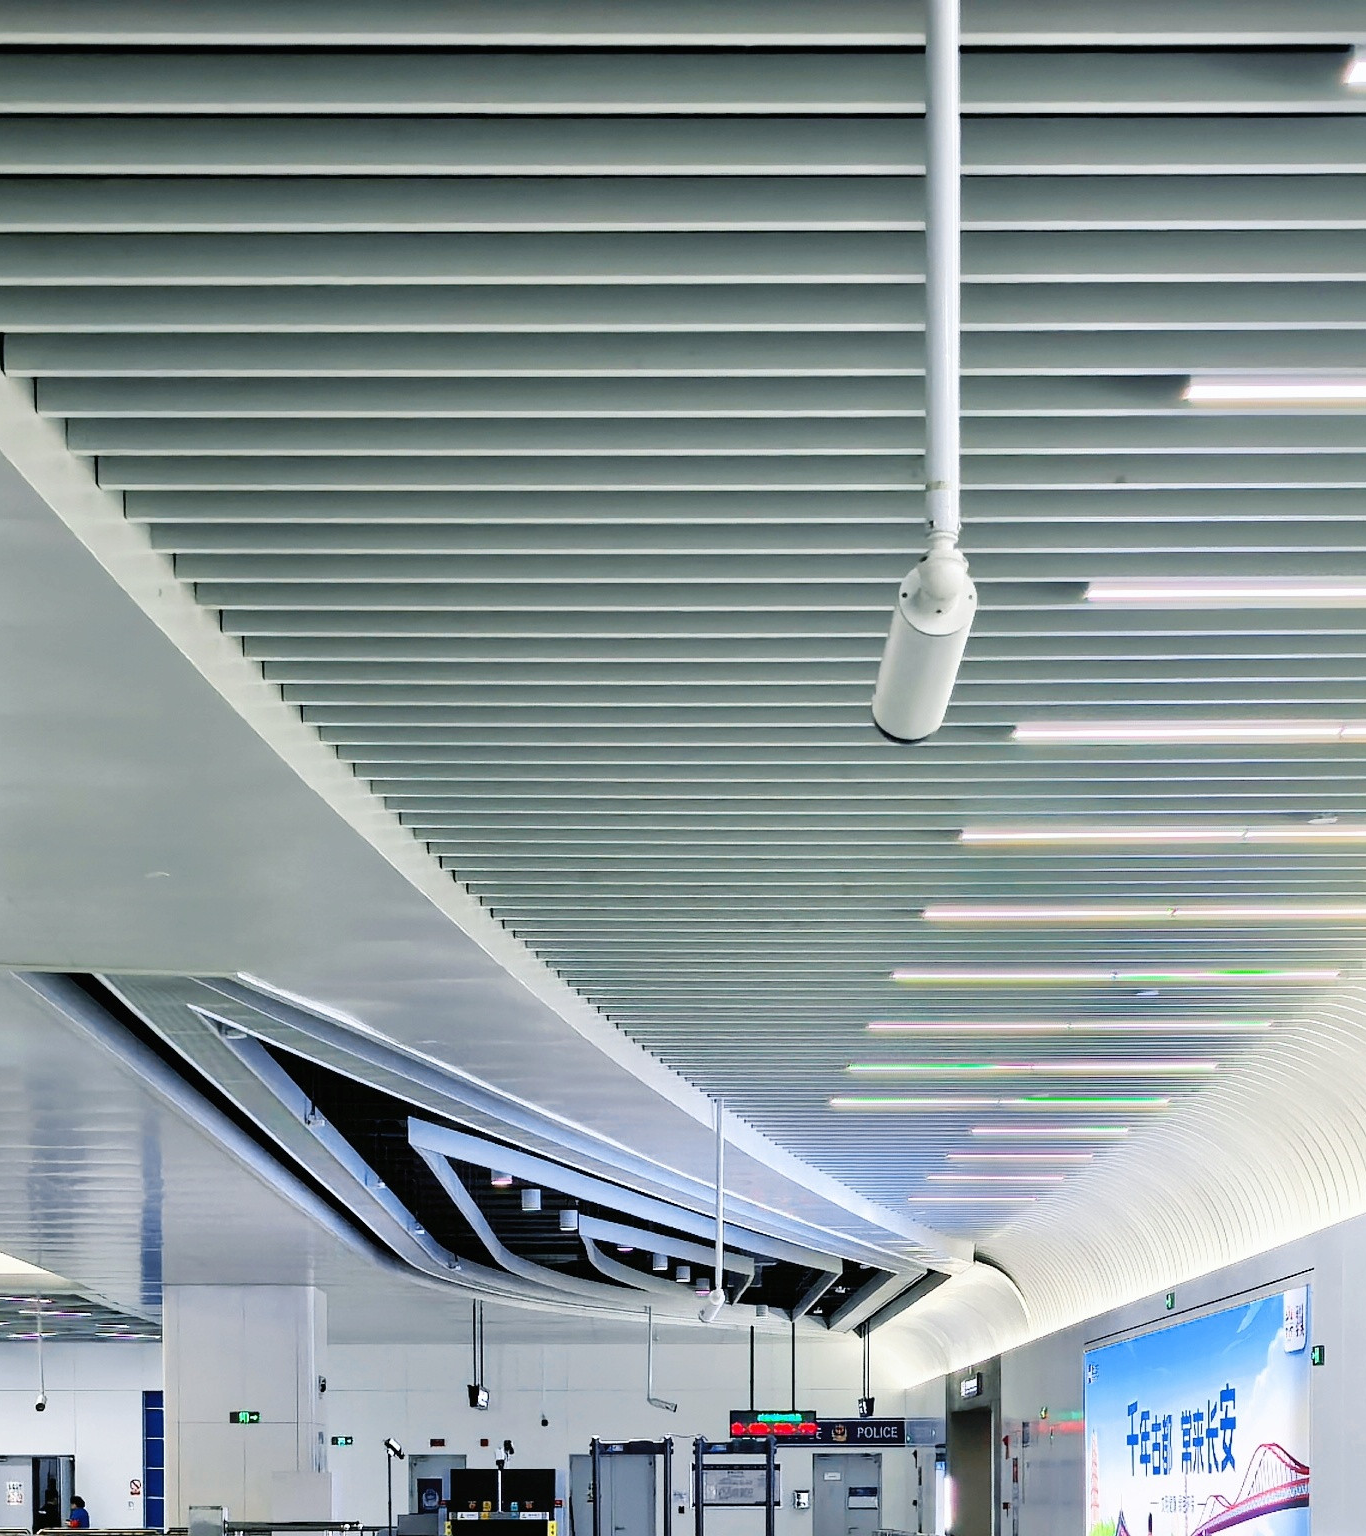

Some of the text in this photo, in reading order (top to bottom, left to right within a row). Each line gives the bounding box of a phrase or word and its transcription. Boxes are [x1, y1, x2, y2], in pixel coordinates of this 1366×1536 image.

[857, 1426, 898, 1439] POLICE
[1126, 1383, 1236, 1477] 千年古都 常来长安
